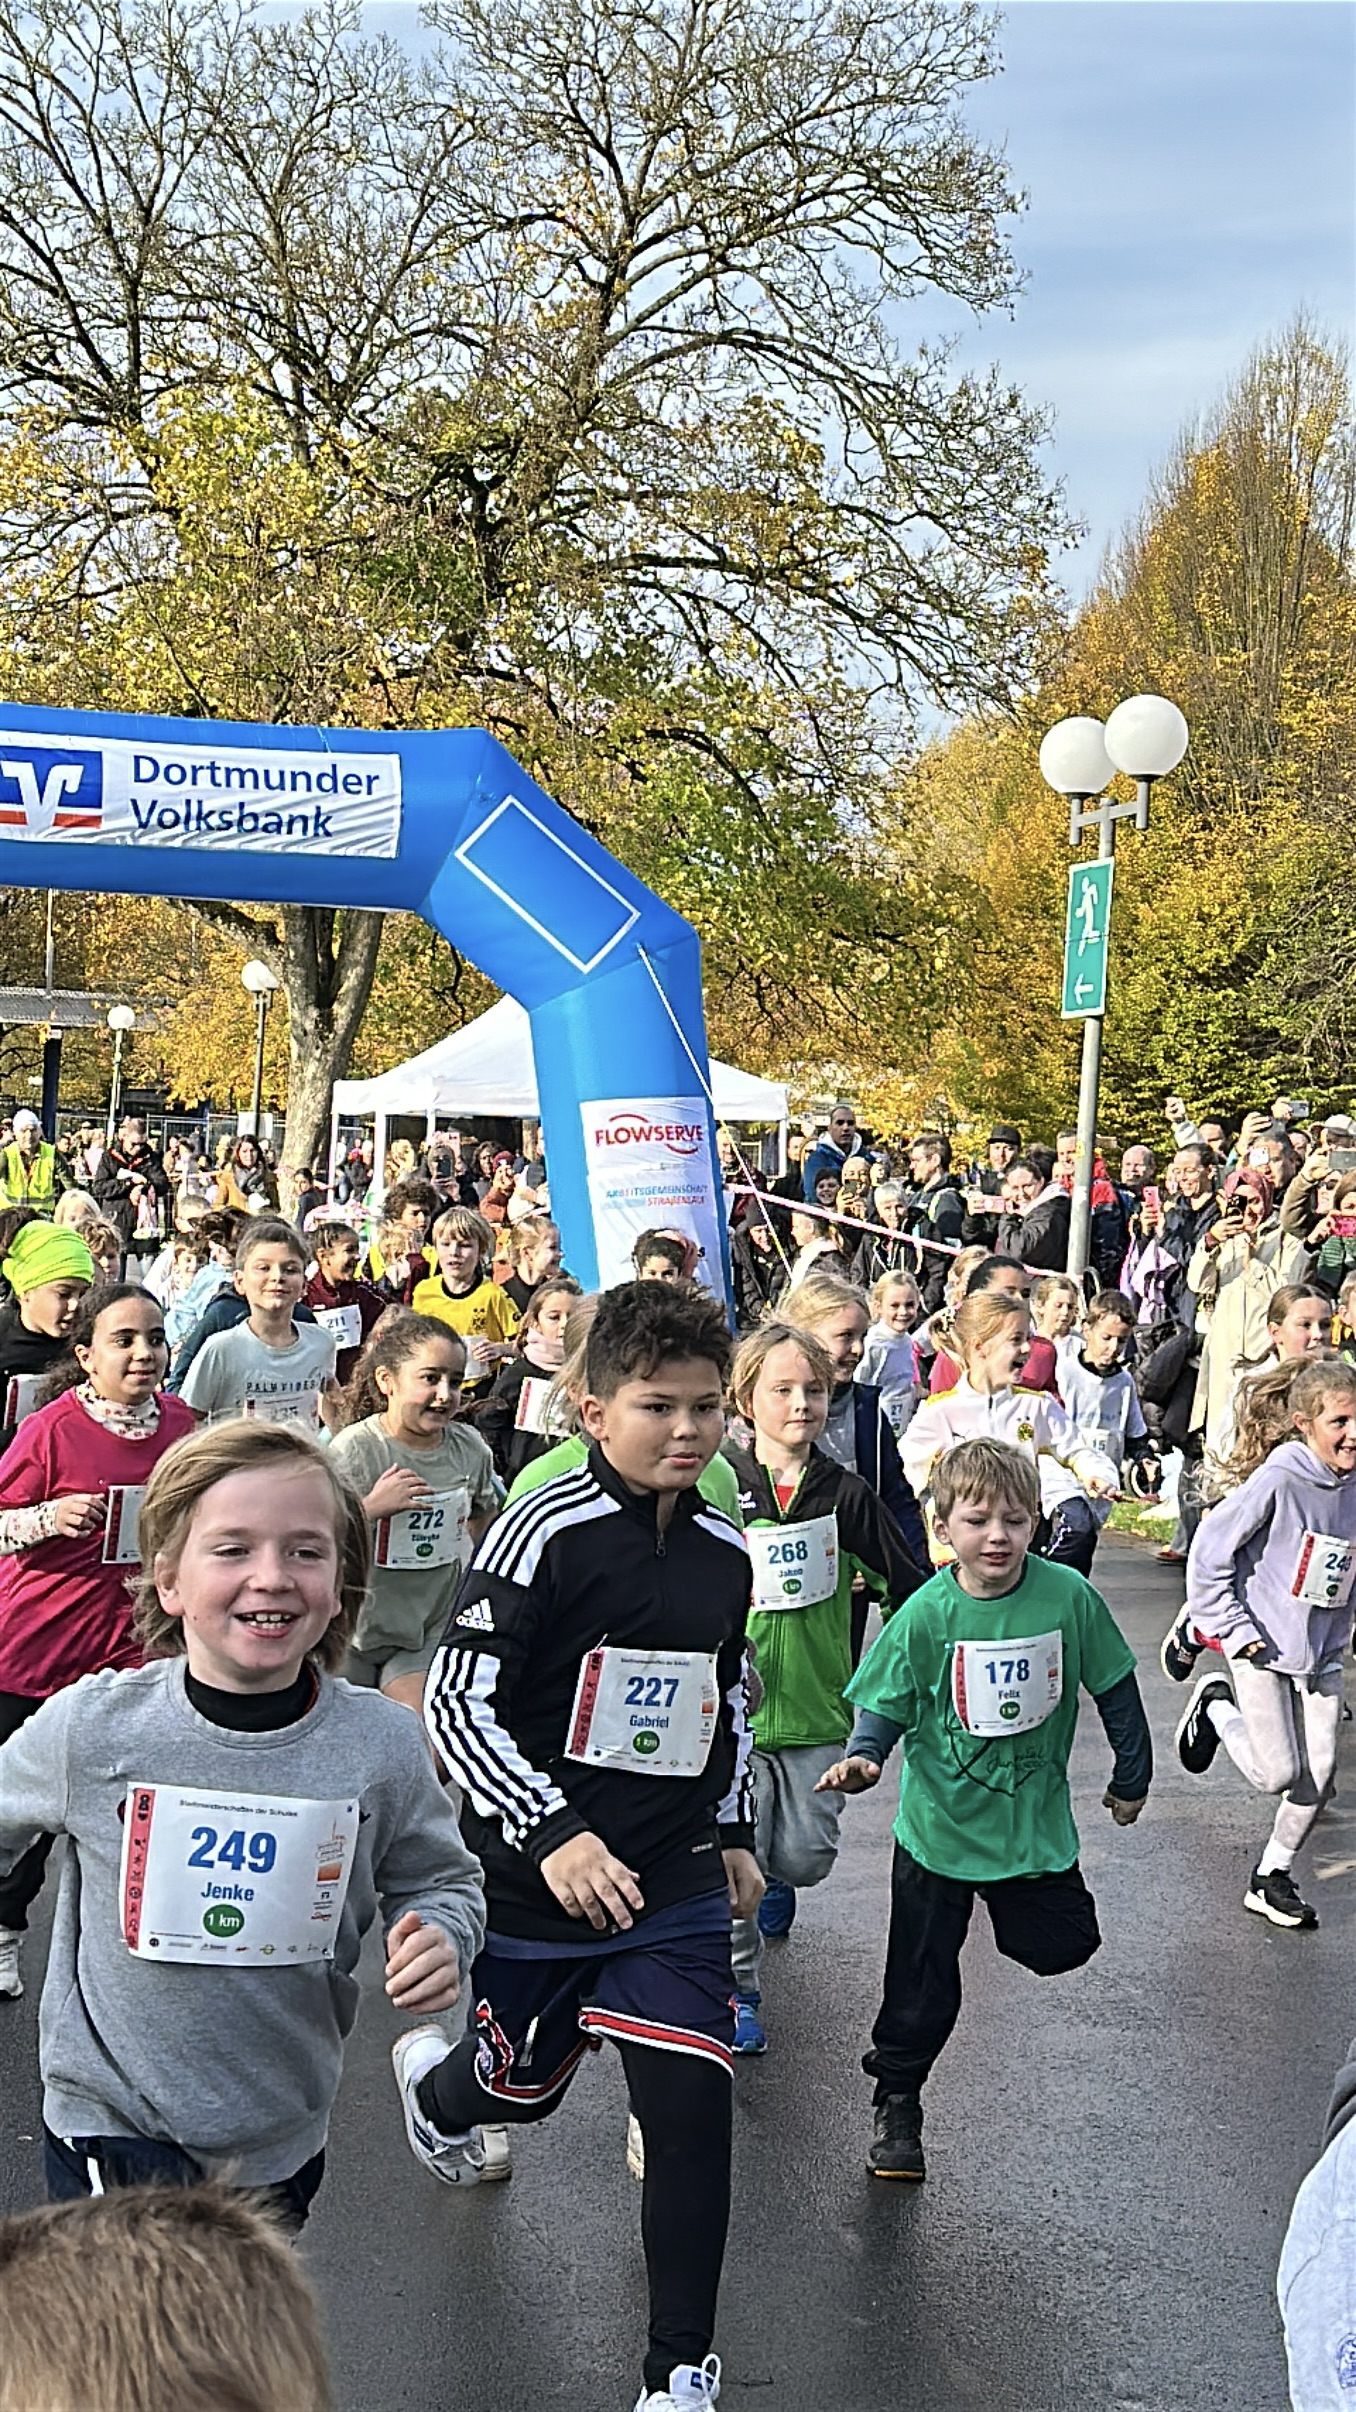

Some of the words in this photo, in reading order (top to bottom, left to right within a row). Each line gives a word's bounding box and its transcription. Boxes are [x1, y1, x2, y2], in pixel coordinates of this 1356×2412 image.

[132, 754, 381, 796] Dortmunder
[129, 798, 334, 837] Volksbank
[594, 1124, 705, 1147] FLOWSERVE
[408, 1509, 445, 1530] 272
[767, 1540, 809, 1564] 268
[985, 1658, 1031, 1684] 178
[624, 1676, 680, 1708] 227
[998, 1689, 1022, 1700] Felix
[629, 1714, 670, 1729] Gabriel
[187, 1826, 278, 1874] 249
[200, 1882, 255, 1902] Jenke
[207, 1913, 215, 1926] 1
[218, 1914, 241, 1929] km
